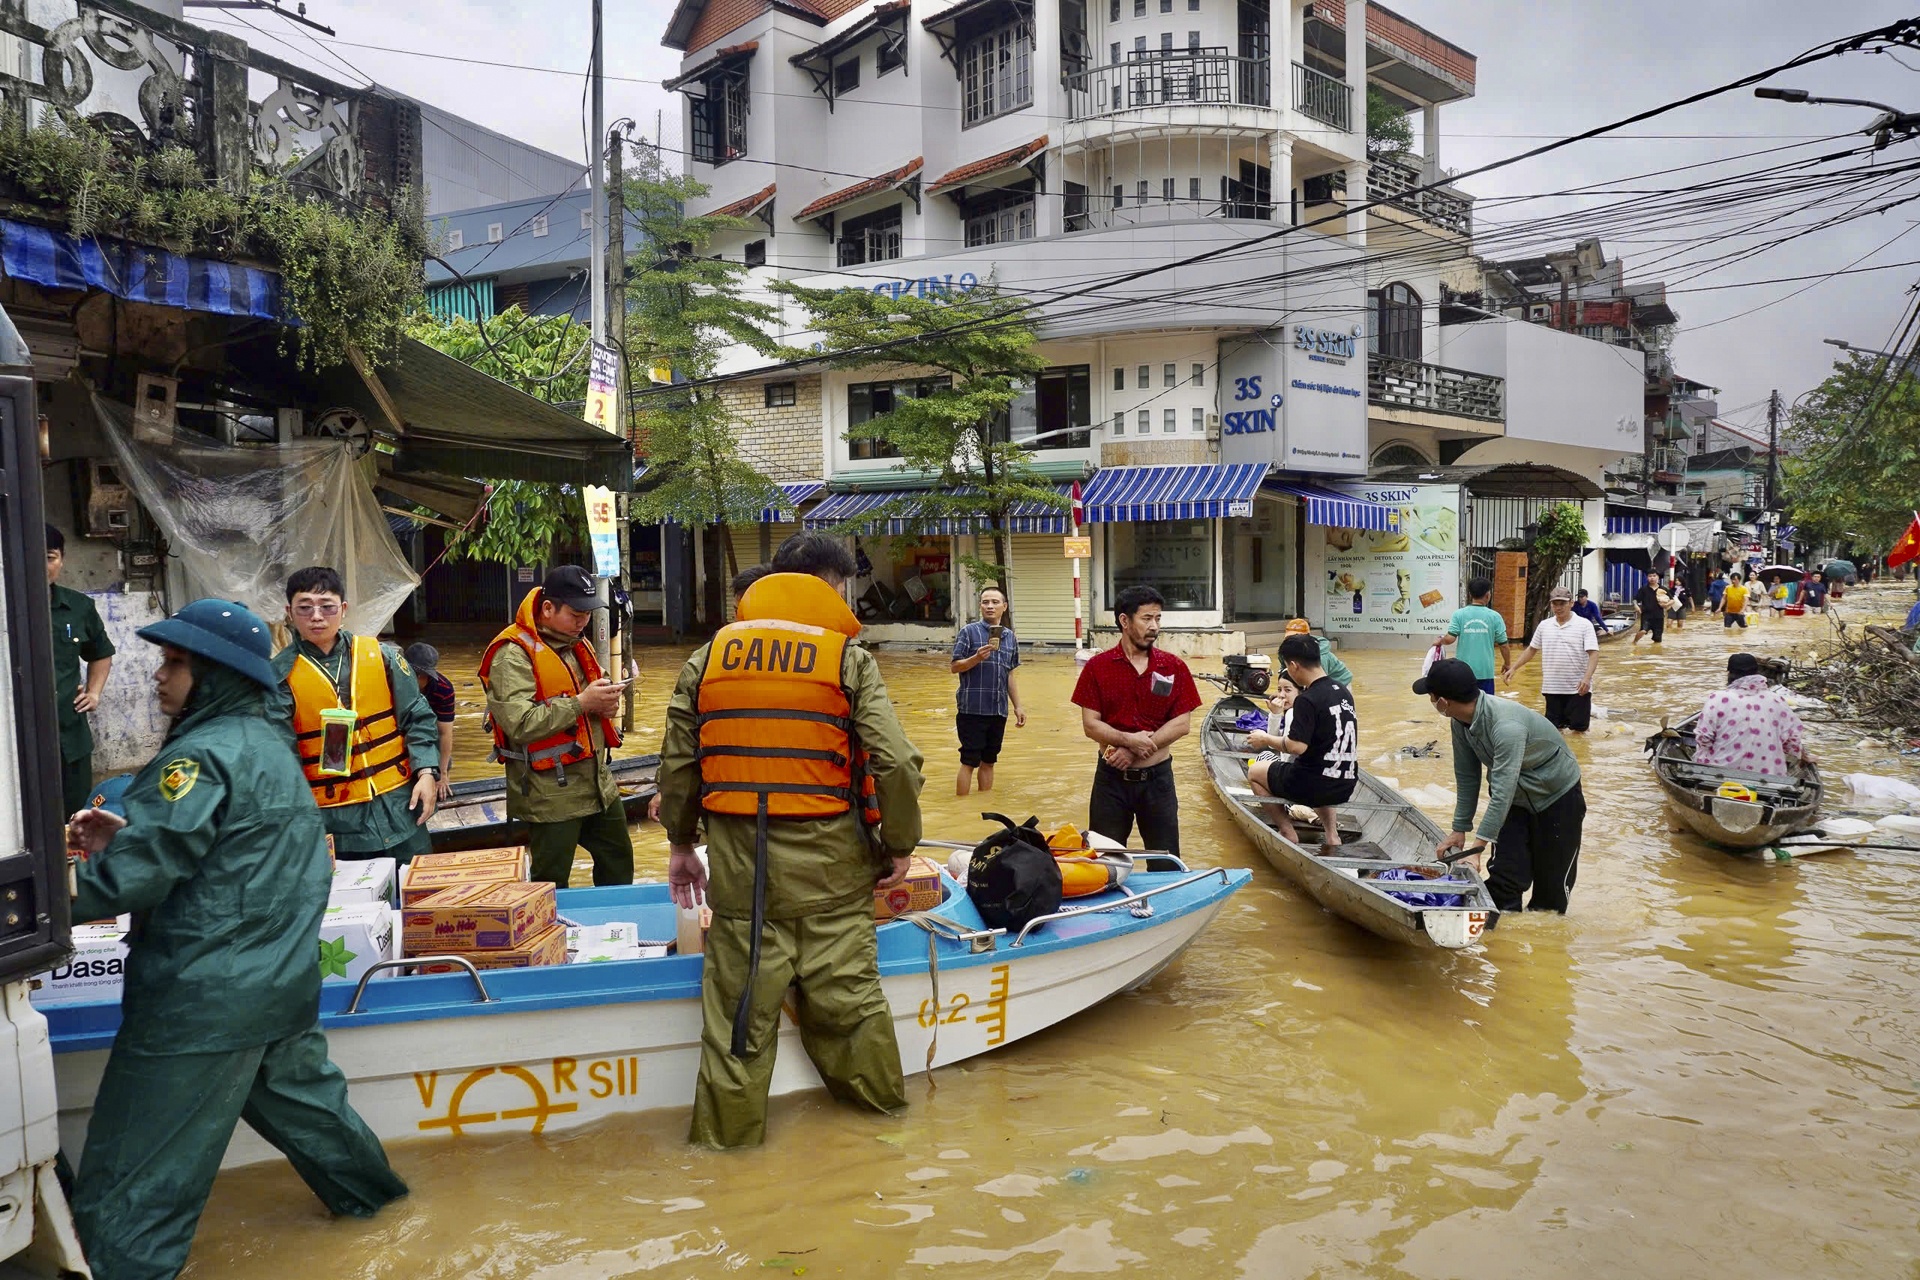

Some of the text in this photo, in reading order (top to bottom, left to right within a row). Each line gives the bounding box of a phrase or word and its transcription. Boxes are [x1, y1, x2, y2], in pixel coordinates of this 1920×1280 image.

[1294, 325, 1356, 358] 3S SKIN
[1234, 375, 1262, 401] 3S
[594, 398, 604, 419] 2
[1224, 408, 1277, 436] SKIN
[1365, 490, 1411, 502] 3S SKIN
[721, 637, 818, 674] CAND
[52, 958, 124, 980] Dasa
[918, 993, 970, 1028] 0.2
[414, 1070, 438, 1108] V
